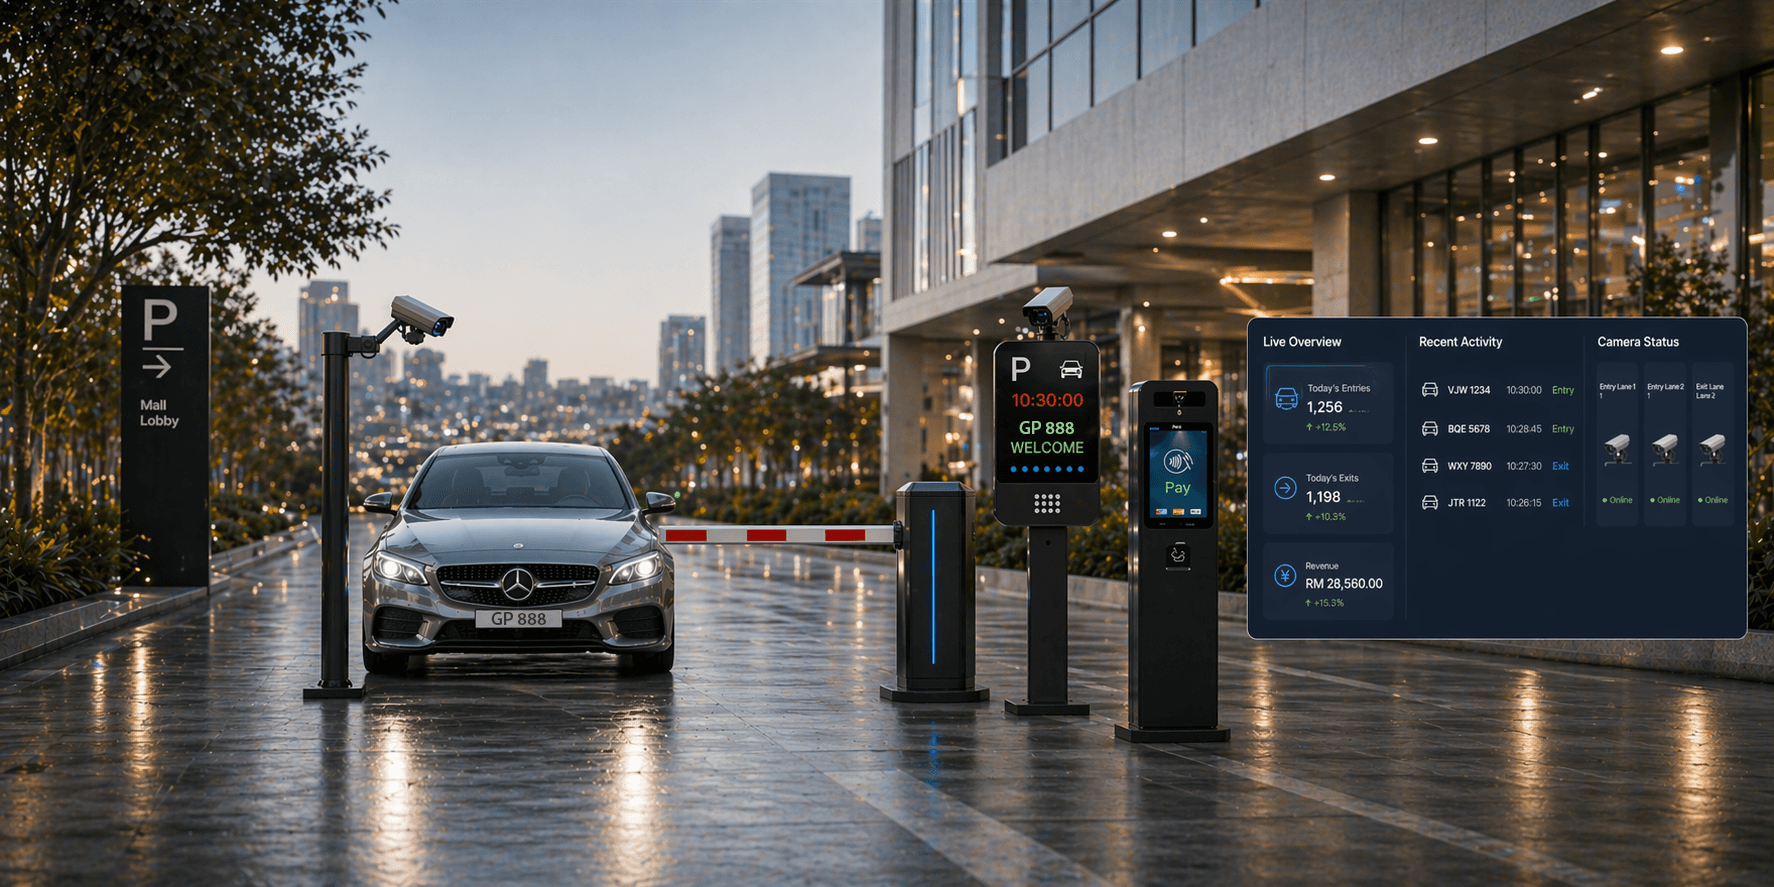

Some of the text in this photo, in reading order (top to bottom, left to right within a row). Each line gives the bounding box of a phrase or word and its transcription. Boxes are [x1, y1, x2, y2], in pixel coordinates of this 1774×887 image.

[143, 298, 178, 342] P
[1011, 356, 1031, 382] P
[140, 399, 167, 411] Mall
[1012, 393, 1084, 408] 10:30:00
[140, 414, 180, 430] Lobby
[1019, 420, 1075, 435] GP 888
[1010, 441, 1084, 455] WELCOME
[1165, 481, 1192, 496] Pay
[491, 612, 547, 626] GP 888
